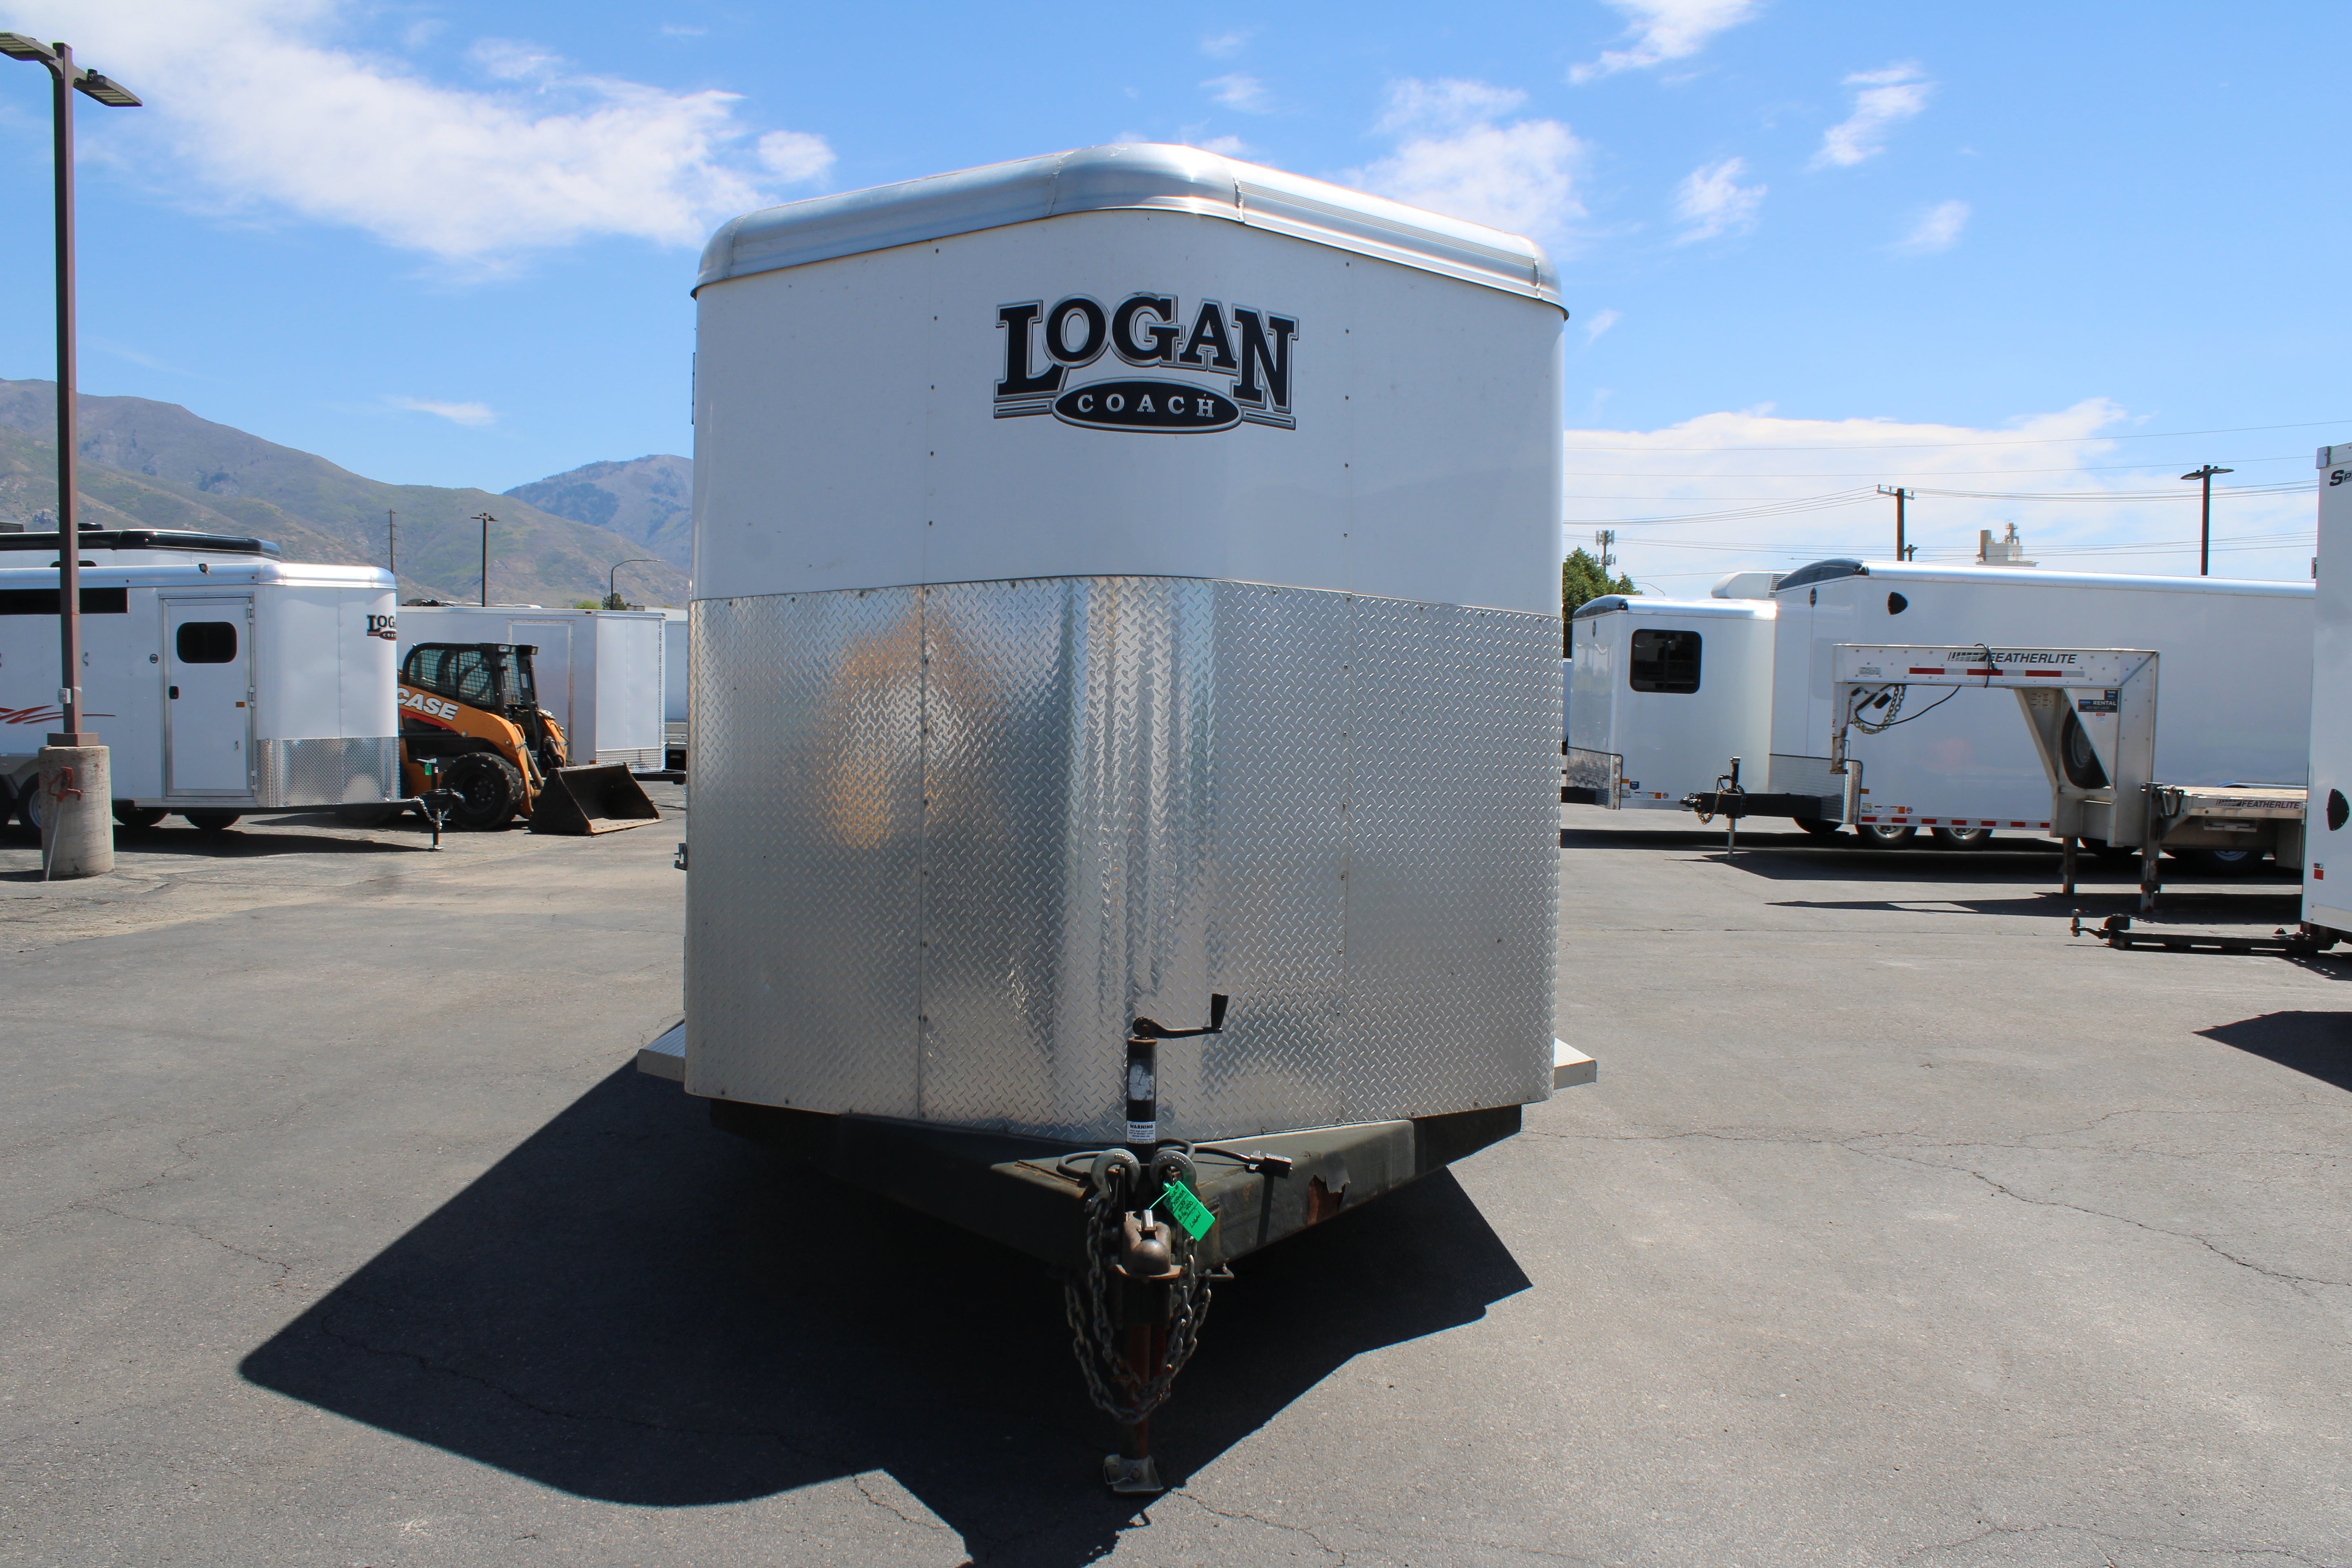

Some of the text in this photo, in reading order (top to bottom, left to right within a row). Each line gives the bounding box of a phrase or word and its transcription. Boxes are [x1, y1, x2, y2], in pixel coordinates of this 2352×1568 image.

[993, 292, 1299, 414] LOGAN
[1077, 394, 1214, 418] COACH
[398, 687, 459, 721] CASE
[2242, 800, 2300, 808] FEATHERLITE
